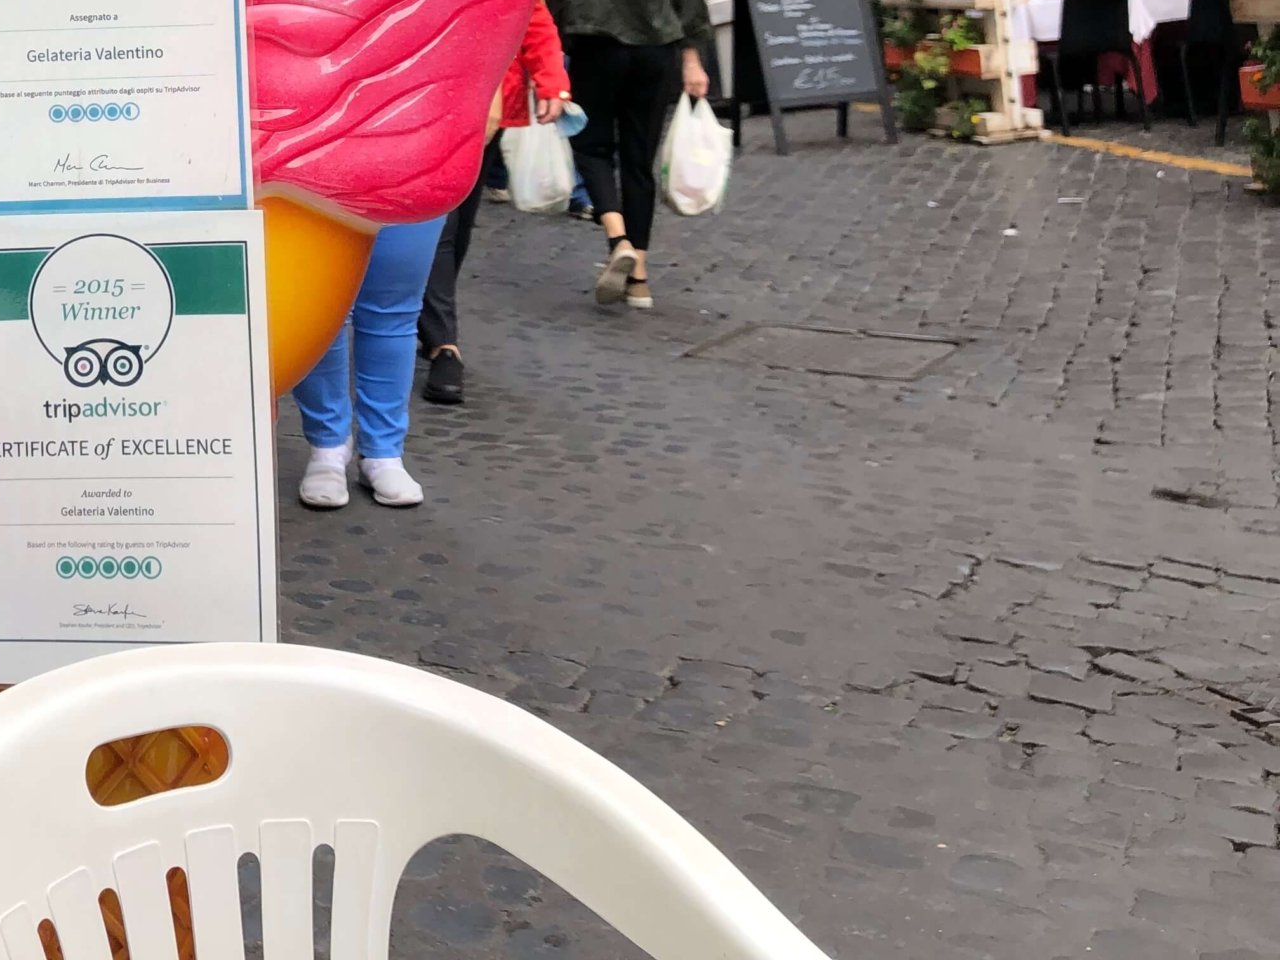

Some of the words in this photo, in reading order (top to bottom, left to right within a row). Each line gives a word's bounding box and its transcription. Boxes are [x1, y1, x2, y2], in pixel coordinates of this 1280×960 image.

[69, 13, 111, 24] Assegnato
[26, 47, 92, 64] Gelateria
[94, 45, 164, 61] Valentino
[0, 91, 15, 99] base
[24, 91, 53, 100] seguente
[54, 89, 87, 98] punteggio
[87, 87, 118, 96] attribuito
[119, 87, 135, 97] dagli
[136, 86, 154, 96] ospiti
[164, 85, 201, 94] TripAdvisor
[73, 278, 125, 298] 2015
[61, 302, 141, 322] Winner
[43, 396, 162, 423] tripadvisor
[94, 438, 115, 460] of
[121, 438, 233, 456] EXCELLENCE
[80, 489, 121, 499] Awarded
[123, 489, 133, 499] to
[60, 506, 105, 517] Gelateria
[107, 506, 155, 517] Valentino
[27, 541, 46, 549] Based
[56, 541, 67, 549] the
[67, 541, 96, 550] following
[97, 541, 115, 550] rating
[115, 541, 124, 550] by
[125, 542, 145, 550] guests
[156, 541, 191, 550] TripAdvisor
